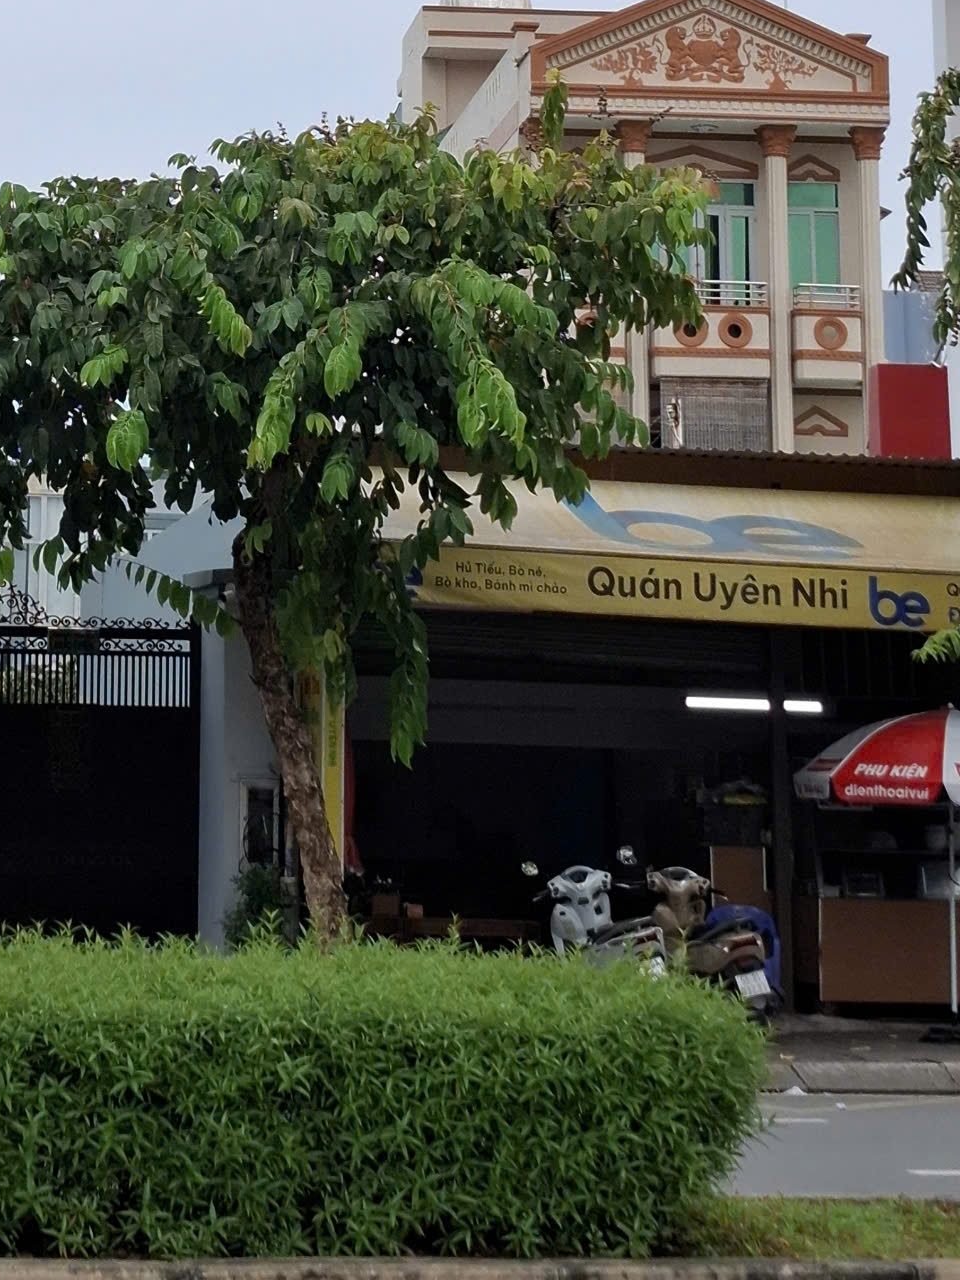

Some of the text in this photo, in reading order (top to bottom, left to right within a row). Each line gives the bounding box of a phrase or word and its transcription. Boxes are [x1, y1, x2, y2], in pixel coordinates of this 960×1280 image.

[455, 577, 482, 591] kho,
[587, 565, 848, 610] Quán Uyên Nhi
[868, 574, 931, 628] be
[890, 762, 928, 780] KIỆN
[844, 783, 929, 800] dienthoaivui
